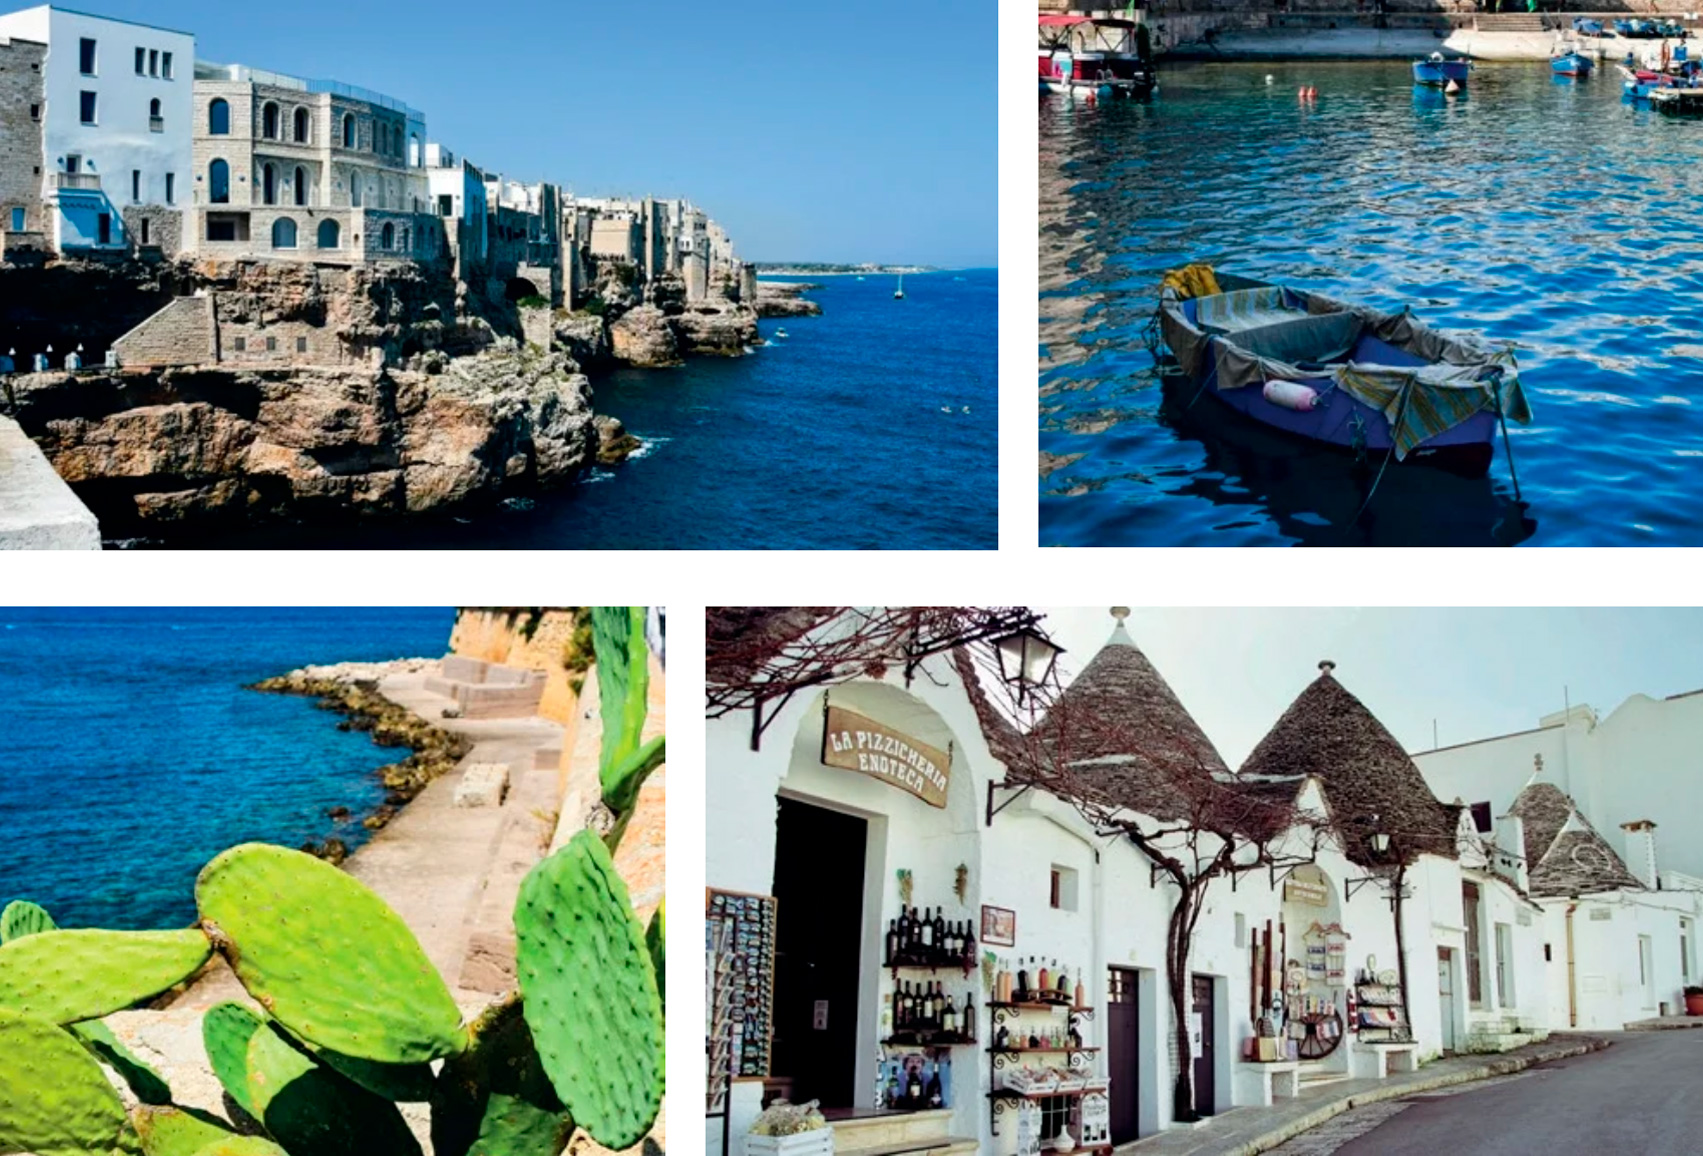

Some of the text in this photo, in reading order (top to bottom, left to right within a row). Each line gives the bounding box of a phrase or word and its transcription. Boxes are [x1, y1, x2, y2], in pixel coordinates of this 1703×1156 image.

[830, 730, 948, 793] LA PIZZICHERIA
[858, 752, 925, 793] ENOTECA
